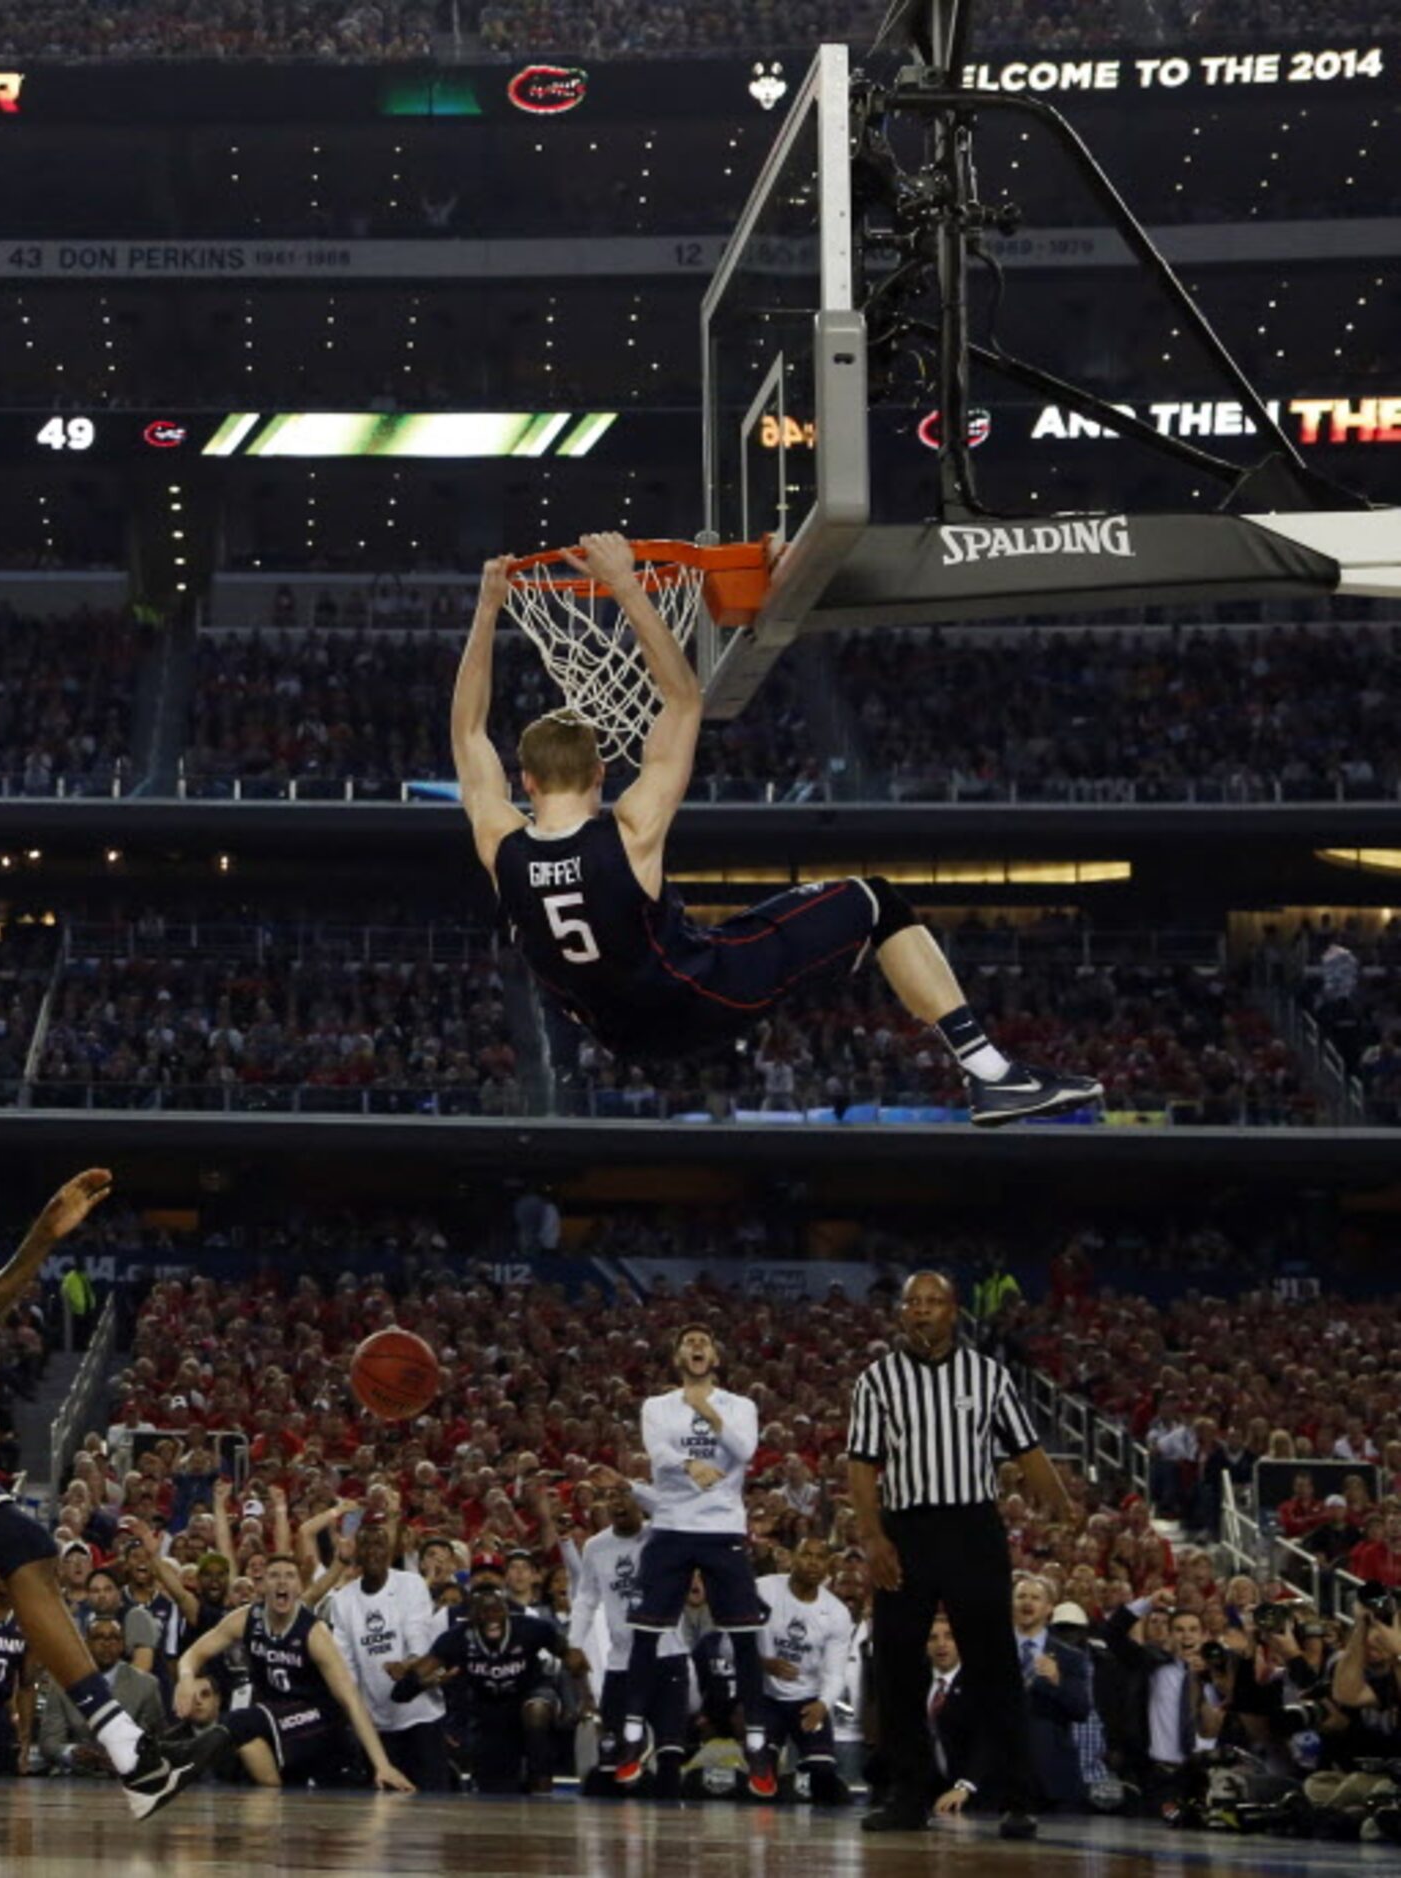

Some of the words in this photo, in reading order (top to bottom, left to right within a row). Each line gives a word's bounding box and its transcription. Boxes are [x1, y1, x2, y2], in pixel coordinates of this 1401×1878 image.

[962, 61, 1119, 91] ELCOME
[1136, 59, 1189, 88] TO
[1201, 55, 1280, 84] THE
[1288, 49, 1383, 80] 2014
[9, 248, 42, 268] 43
[59, 248, 116, 269] DON
[129, 248, 245, 269] PERKINS
[675, 242, 703, 265] 12
[36, 417, 94, 450] 49
[939, 514, 1132, 566] SPALDING
[528, 856, 583, 887] GIFFEY
[542, 892, 601, 964] 5
